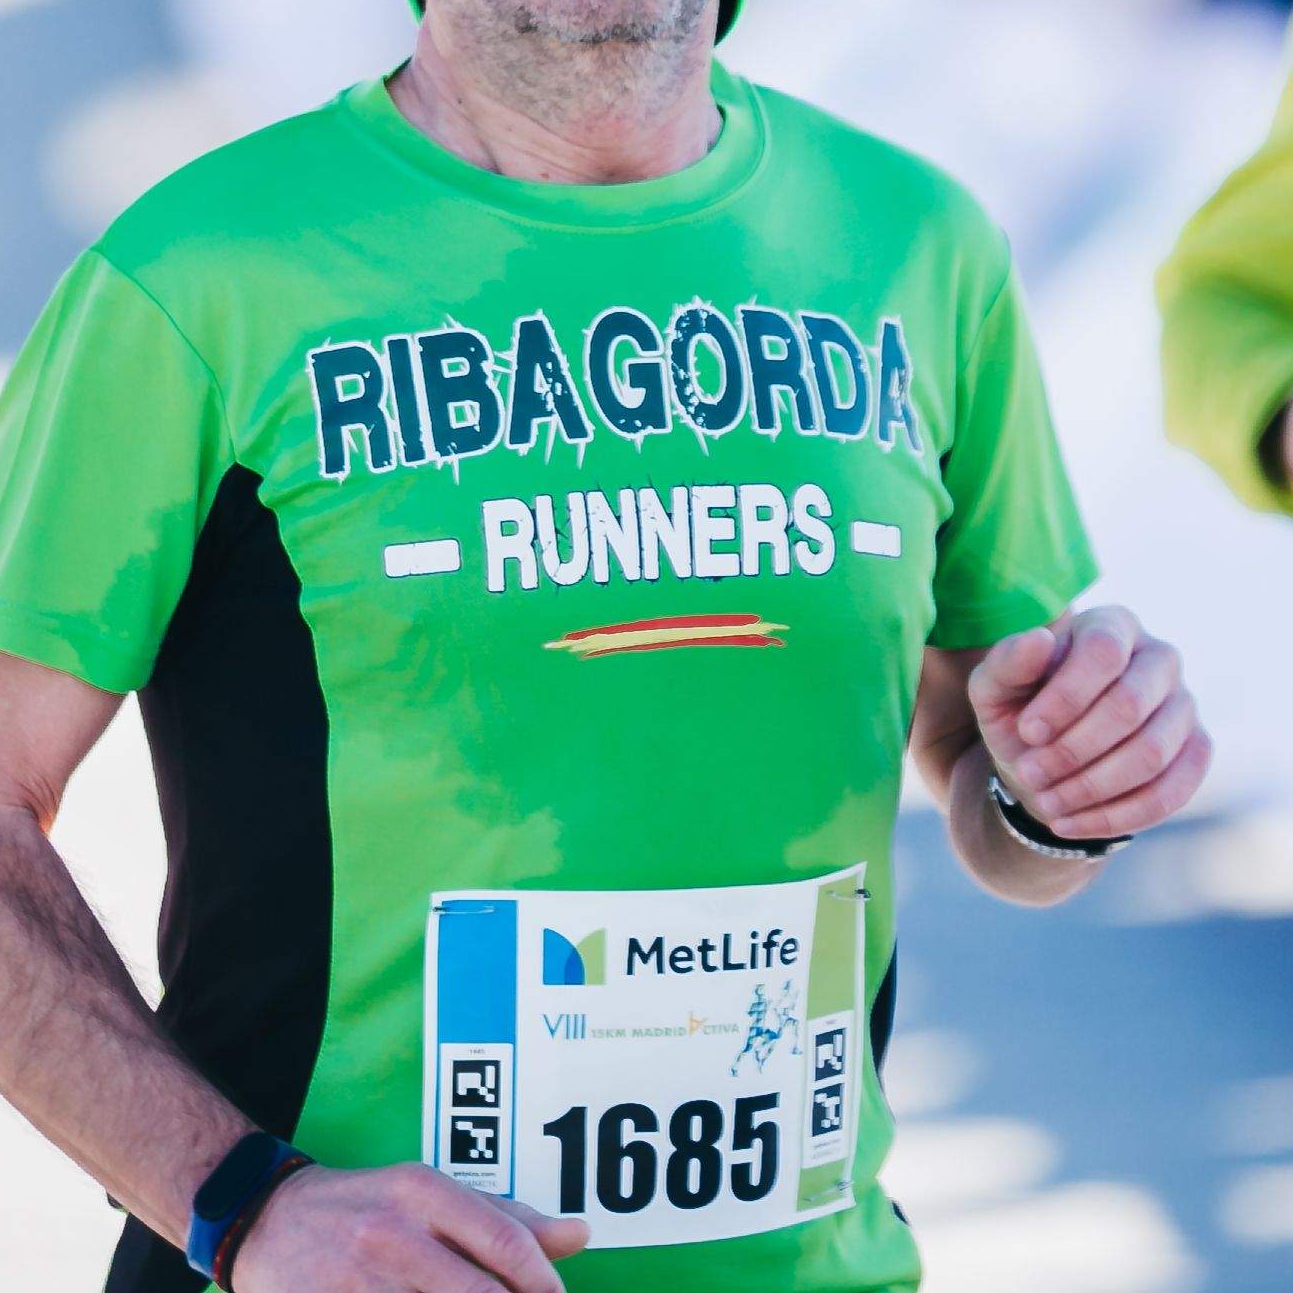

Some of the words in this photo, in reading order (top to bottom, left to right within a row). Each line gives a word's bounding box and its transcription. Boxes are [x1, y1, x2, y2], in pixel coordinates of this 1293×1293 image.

[308, 300, 923, 480] RIBAGORDA
[482, 482, 836, 594] RUNNERS
[626, 928, 800, 976] MetLife
[542, 1013, 586, 1039] VIII
[632, 1026, 687, 1038] MADRID
[542, 1092, 781, 1214] 1685
